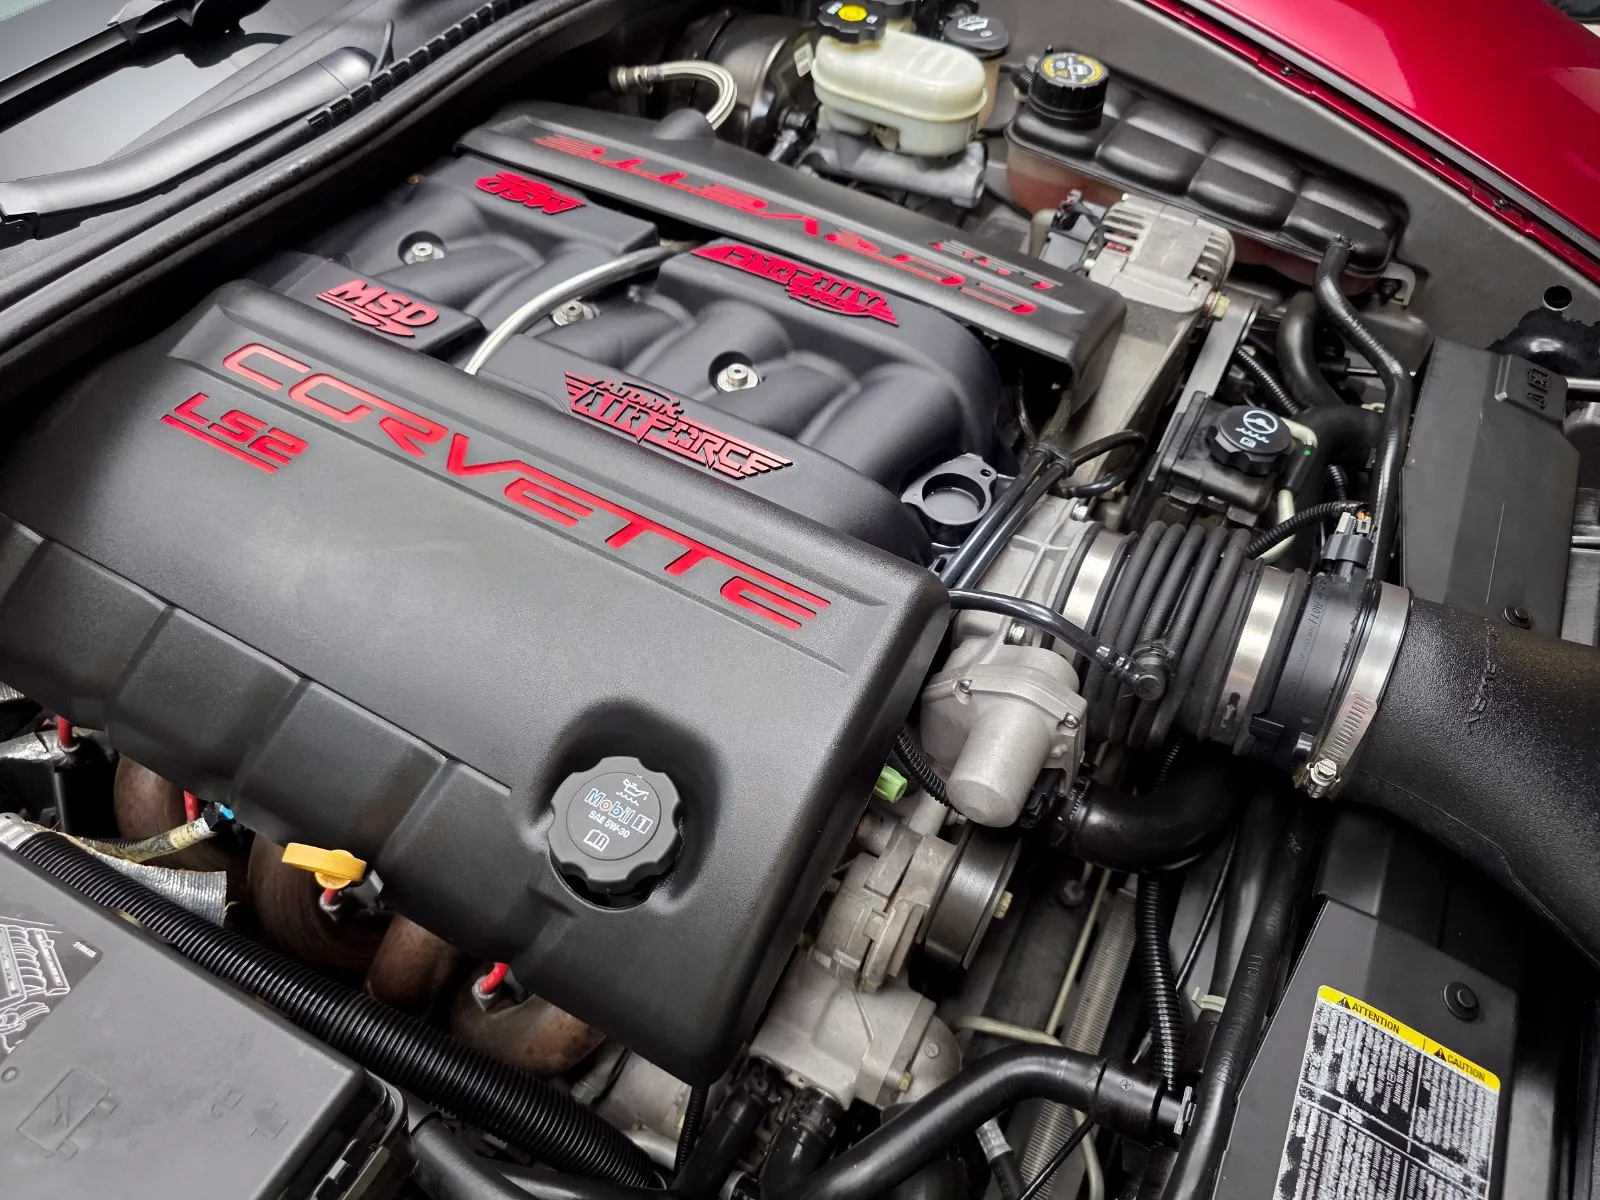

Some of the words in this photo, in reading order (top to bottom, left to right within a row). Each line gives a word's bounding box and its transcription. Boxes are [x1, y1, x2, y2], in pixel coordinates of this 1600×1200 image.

[327, 278, 439, 328] MSD
[172, 392, 309, 466] LS2
[222, 343, 831, 631] CORVETTE
[584, 788, 636, 825] Mobil
[588, 810, 606, 825] SAE
[604, 820, 631, 838] 5W-30
[1350, 1003, 1400, 1034] ATTENTION
[1447, 1054, 1485, 1083] CAUTION
